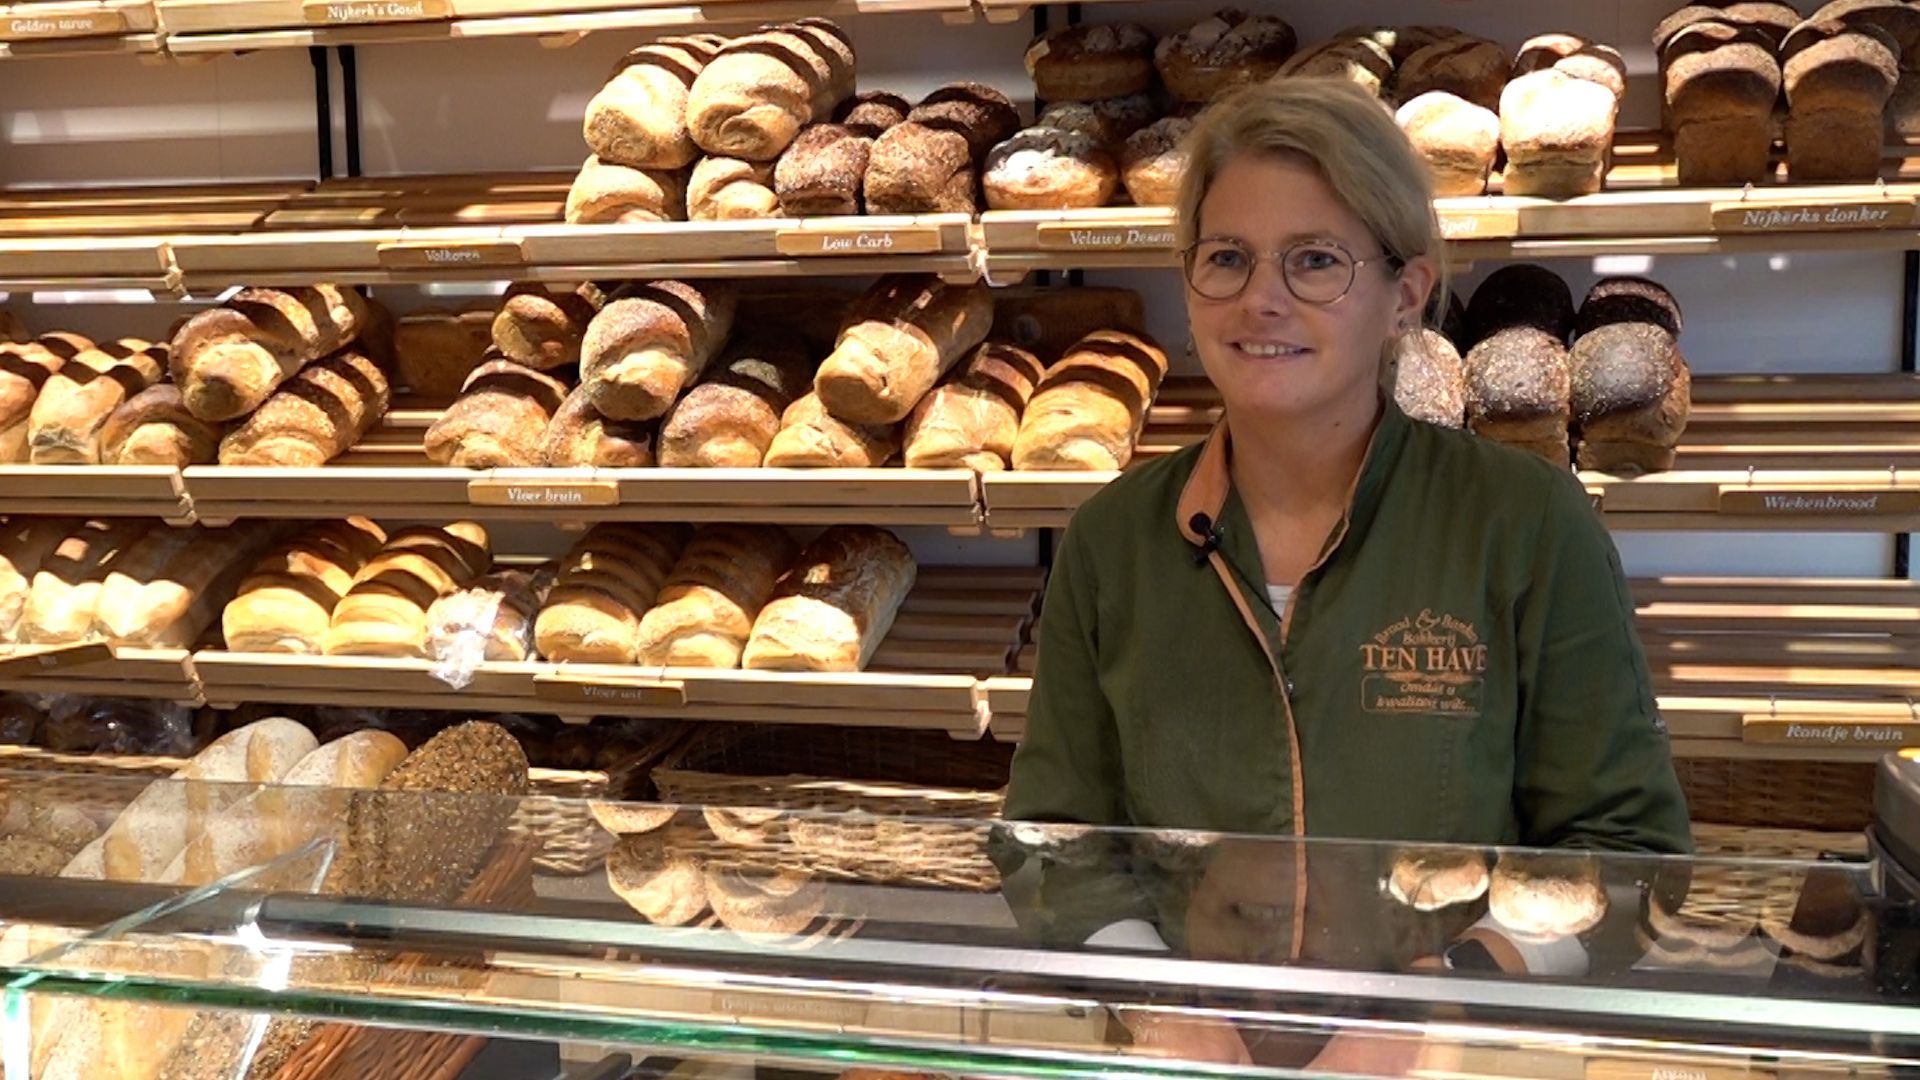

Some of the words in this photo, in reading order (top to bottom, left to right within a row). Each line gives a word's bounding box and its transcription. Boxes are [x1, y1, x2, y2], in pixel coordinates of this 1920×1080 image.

[387, 2, 424, 16] Goud
[1825, 206, 1889, 224] donker
[822, 235, 853, 250] Low
[856, 232, 894, 248] Carb
[424, 249, 481, 261] Volkoren
[507, 487, 542, 501] Vloer
[545, 487, 583, 502] bruin
[1359, 644, 1418, 671] TEN
[1786, 725, 1849, 743] Rondje
[1853, 726, 1904, 741] bruin
